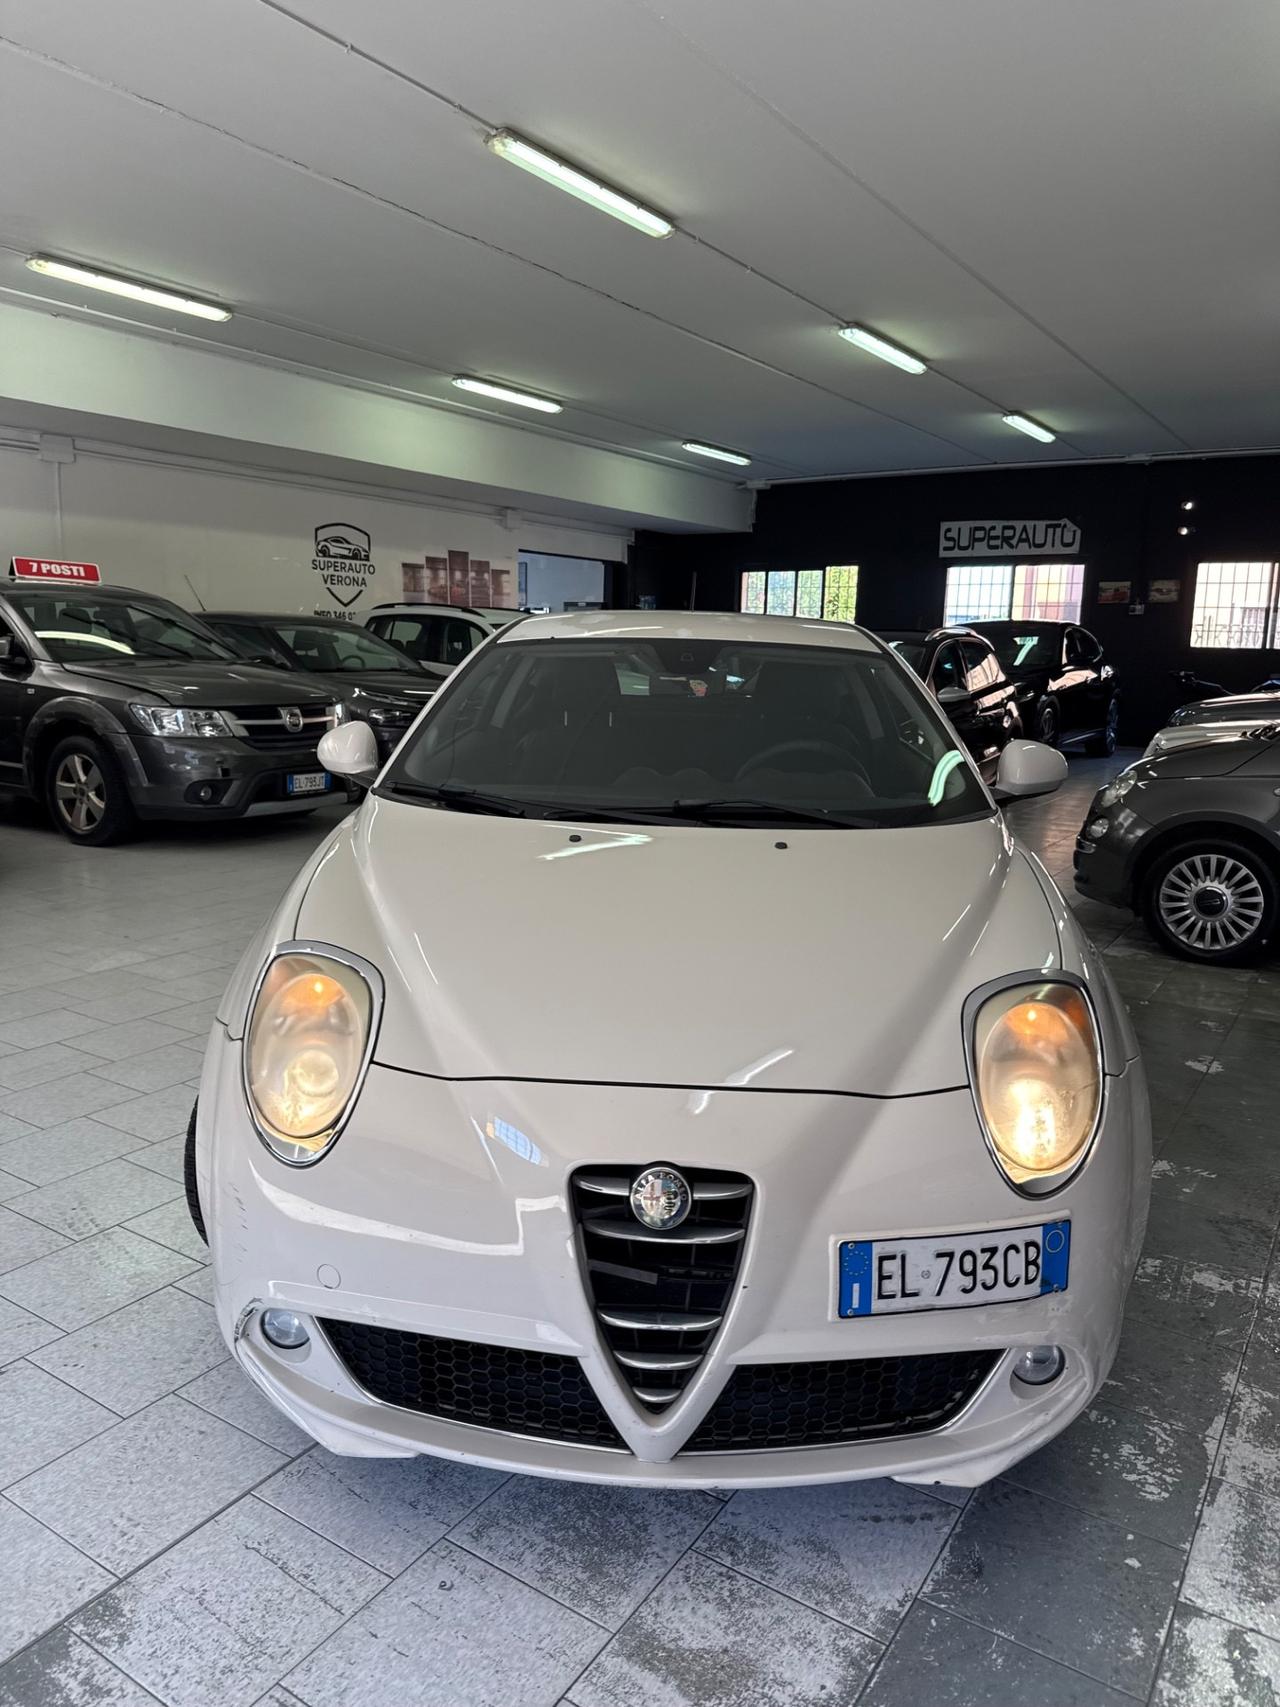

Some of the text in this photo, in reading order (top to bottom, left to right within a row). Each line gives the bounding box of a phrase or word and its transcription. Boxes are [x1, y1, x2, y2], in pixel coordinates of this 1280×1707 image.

[943, 523, 1077, 551] SUPERAUTO
[29, 562, 86, 577] 7 POSTI
[312, 559, 376, 575] SUPERAUTO
[322, 574, 367, 587] VERONA
[635, 1174, 655, 1200] ALFA
[877, 1240, 1041, 1300] EL 793CB
